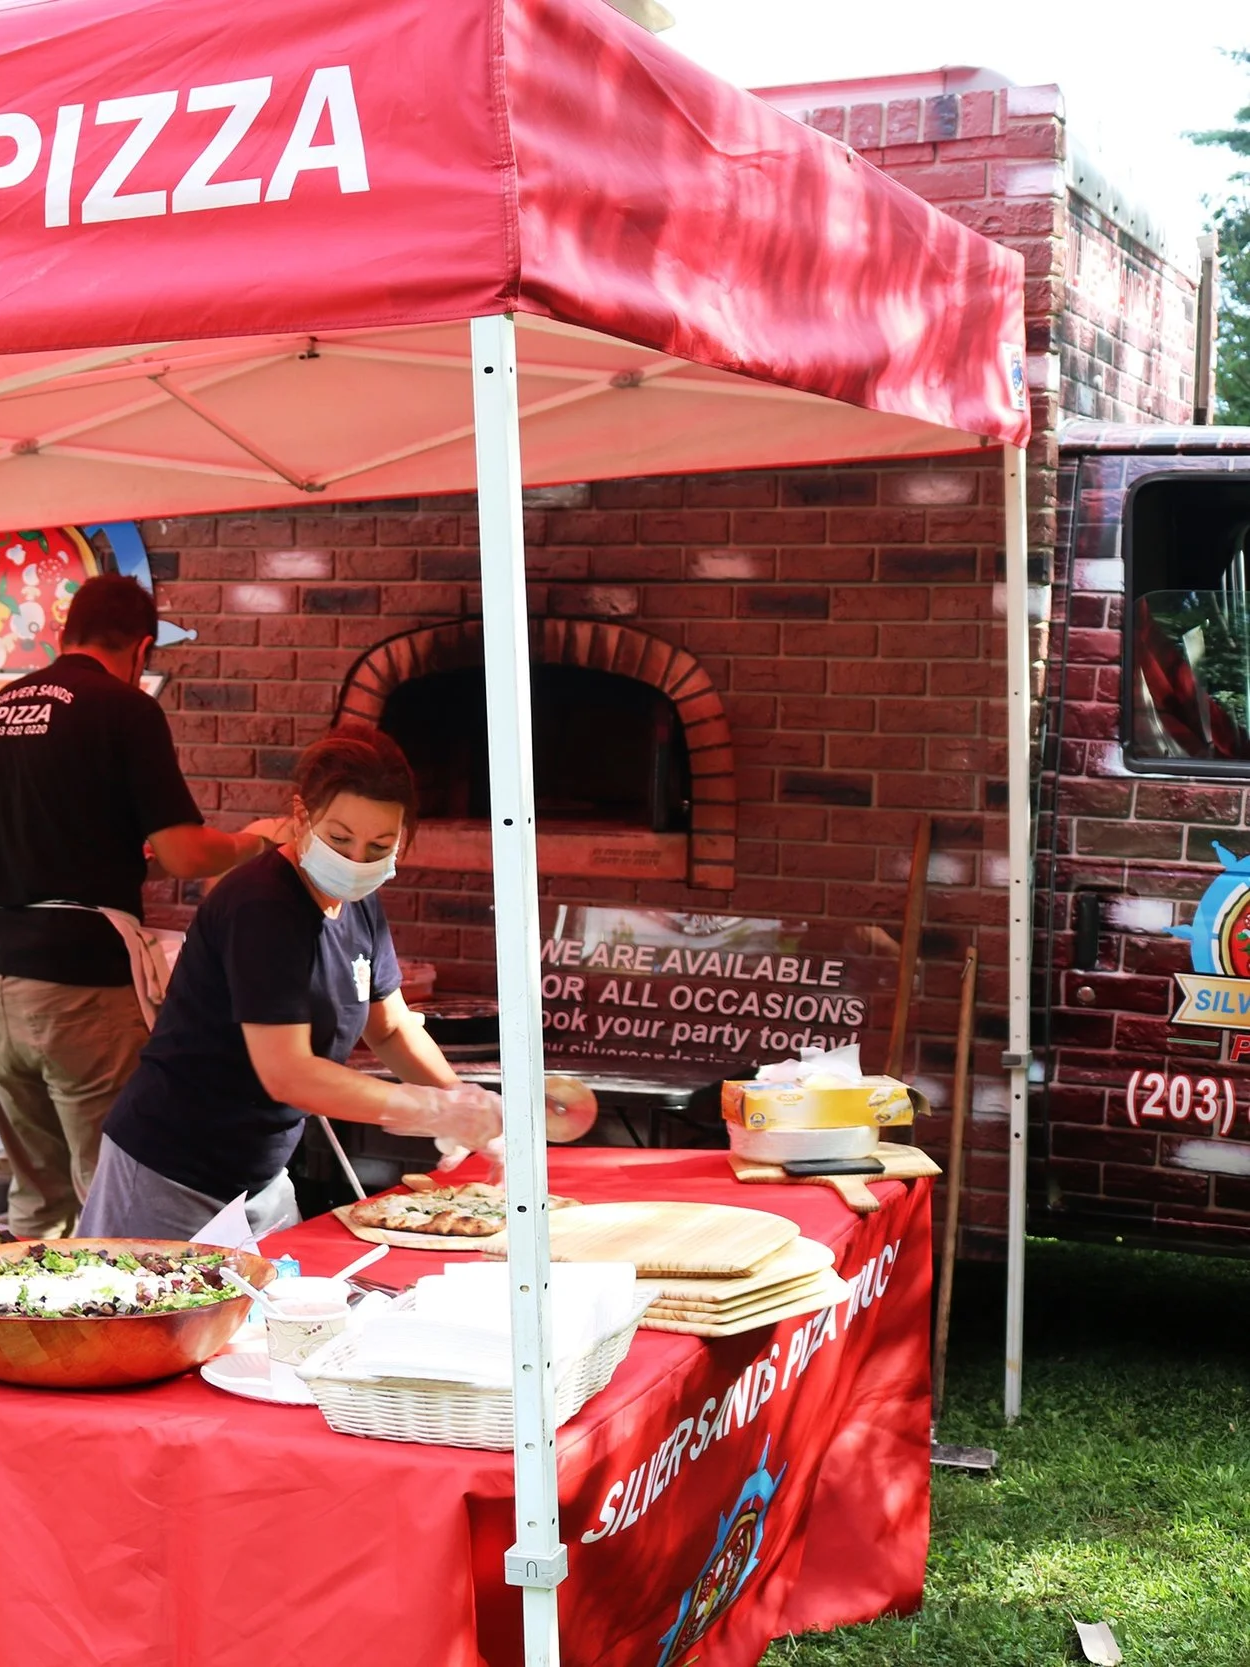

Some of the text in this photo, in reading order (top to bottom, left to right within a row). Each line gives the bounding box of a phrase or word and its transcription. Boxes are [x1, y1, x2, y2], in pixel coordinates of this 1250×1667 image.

[37, 684, 75, 704] SANDS
[588, 943, 656, 972] ARE
[661, 948, 844, 988] AVAILABLE
[541, 974, 865, 1026] OR ALL OCCASIONS
[542, 1006, 588, 1032] ook
[594, 1015, 665, 1040] your
[670, 1020, 751, 1053] party
[1126, 1070, 1236, 1136] (203)
[581, 1417, 695, 1544] SILVER
[690, 1343, 780, 1461] SANDS
